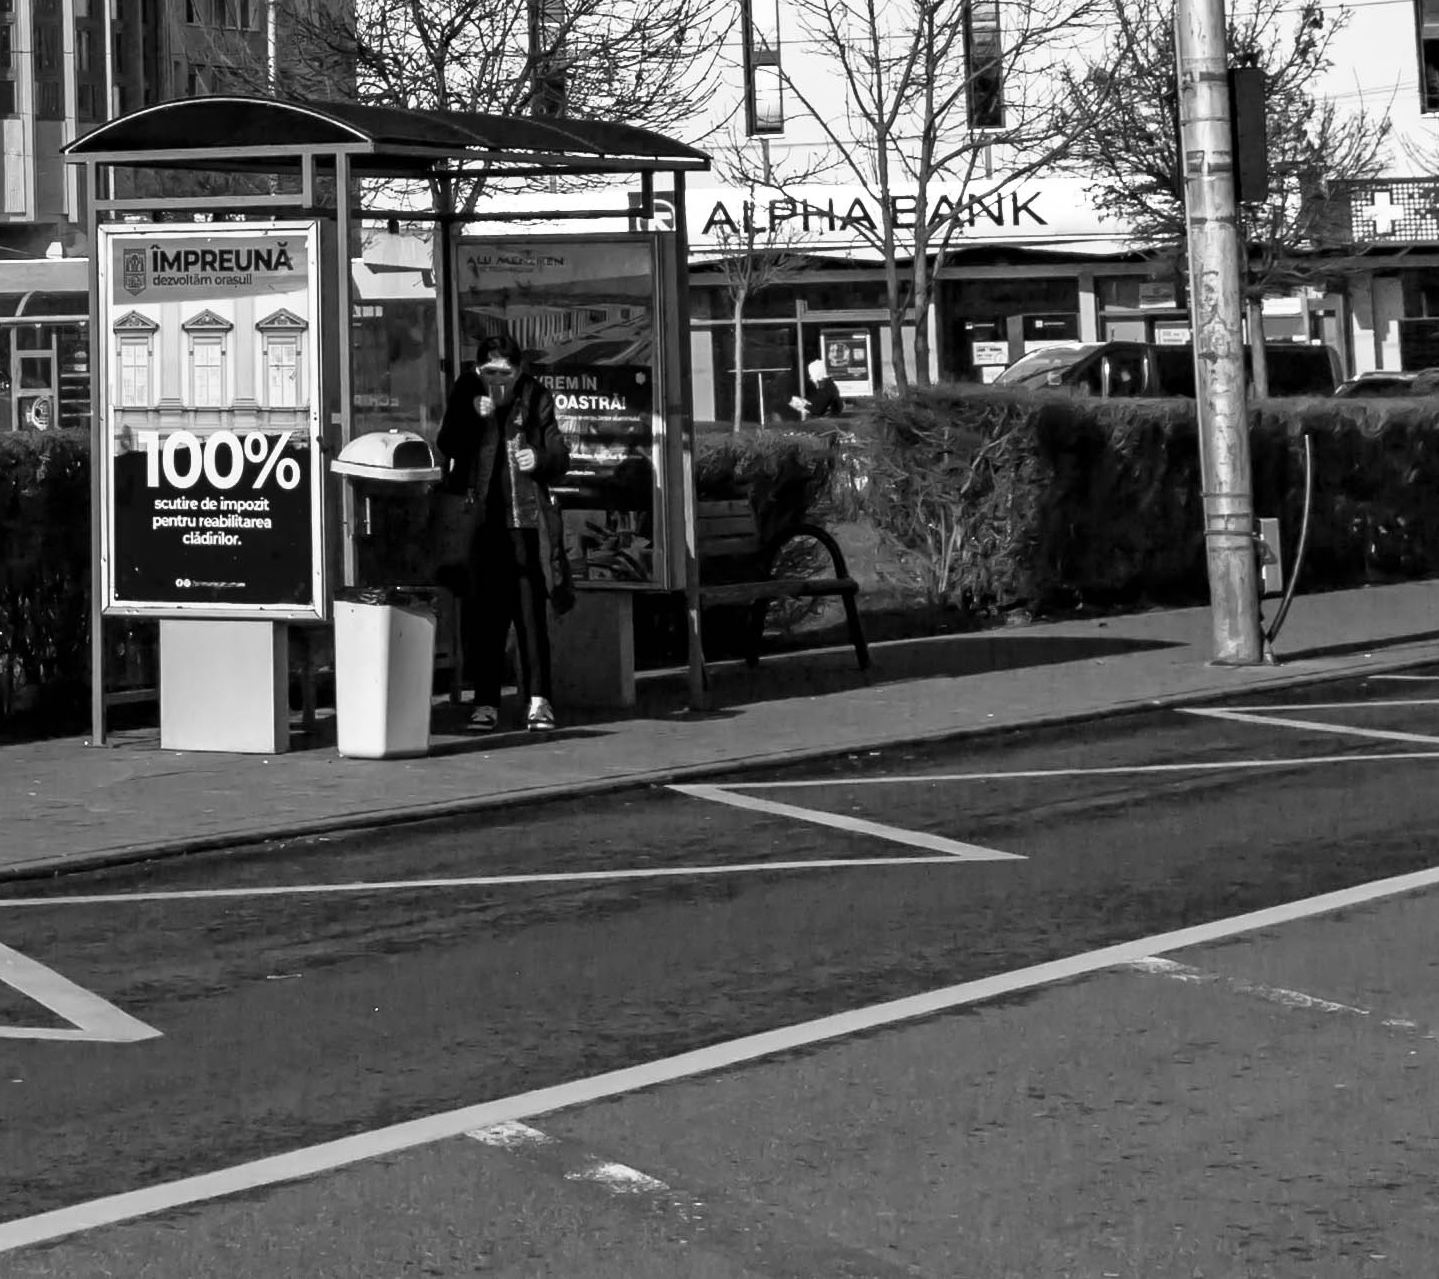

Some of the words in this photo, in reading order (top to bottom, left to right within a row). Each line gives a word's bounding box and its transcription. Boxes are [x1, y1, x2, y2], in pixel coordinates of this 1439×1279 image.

[702, 197, 877, 234] ALPHA
[891, 191, 1048, 229] BANK
[150, 241, 294, 272] ÎMPREUNĂ
[153, 274, 212, 286] dezvoltăm
[552, 393, 626, 410] OASTRĂ!
[137, 430, 301, 490] 100%
[154, 496, 198, 510] scutire
[200, 496, 218, 511] de
[220, 496, 270, 513] impozit
[153, 515, 196, 530] pentru
[199, 514, 272, 529] reabilitarea
[182, 531, 242, 545] clădirilor.
